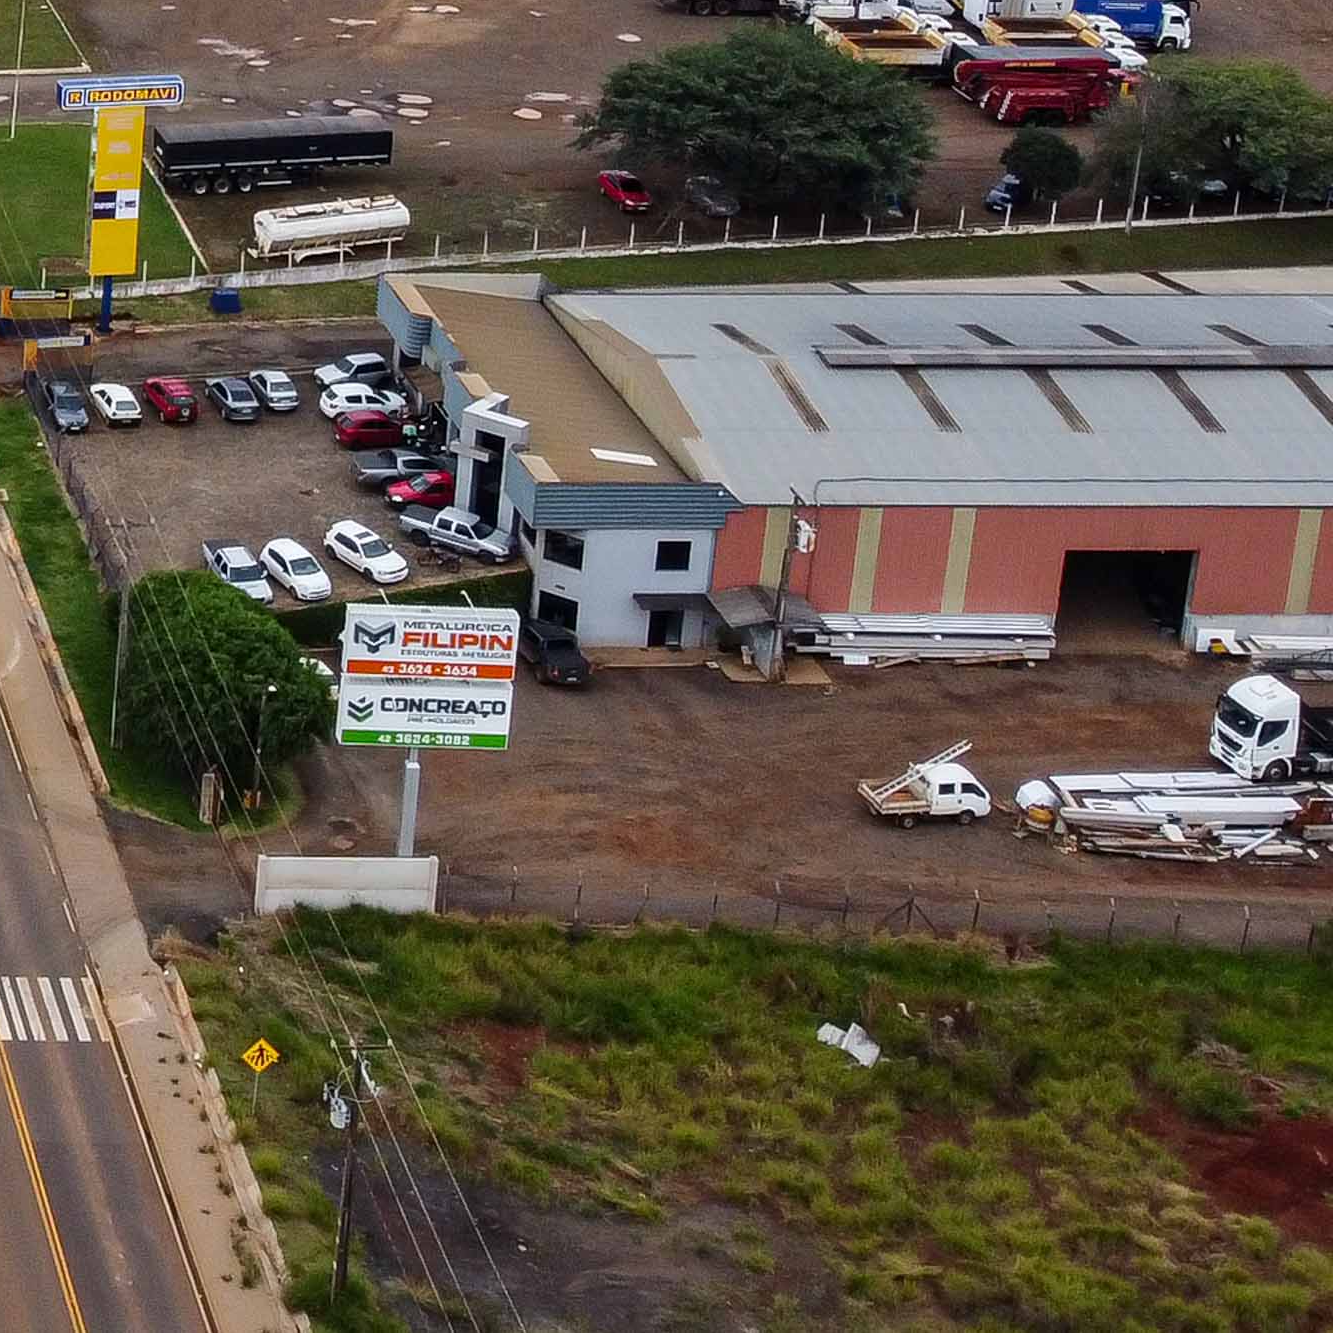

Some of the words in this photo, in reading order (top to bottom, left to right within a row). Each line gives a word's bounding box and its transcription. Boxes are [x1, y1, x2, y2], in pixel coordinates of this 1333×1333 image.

[89, 88, 176, 102] RODOMAVI
[401, 632, 514, 651] FILIPIN
[398, 664, 433, 675] 3624
[442, 665, 478, 676] 3654
[380, 697, 507, 719] CONCREAÇO
